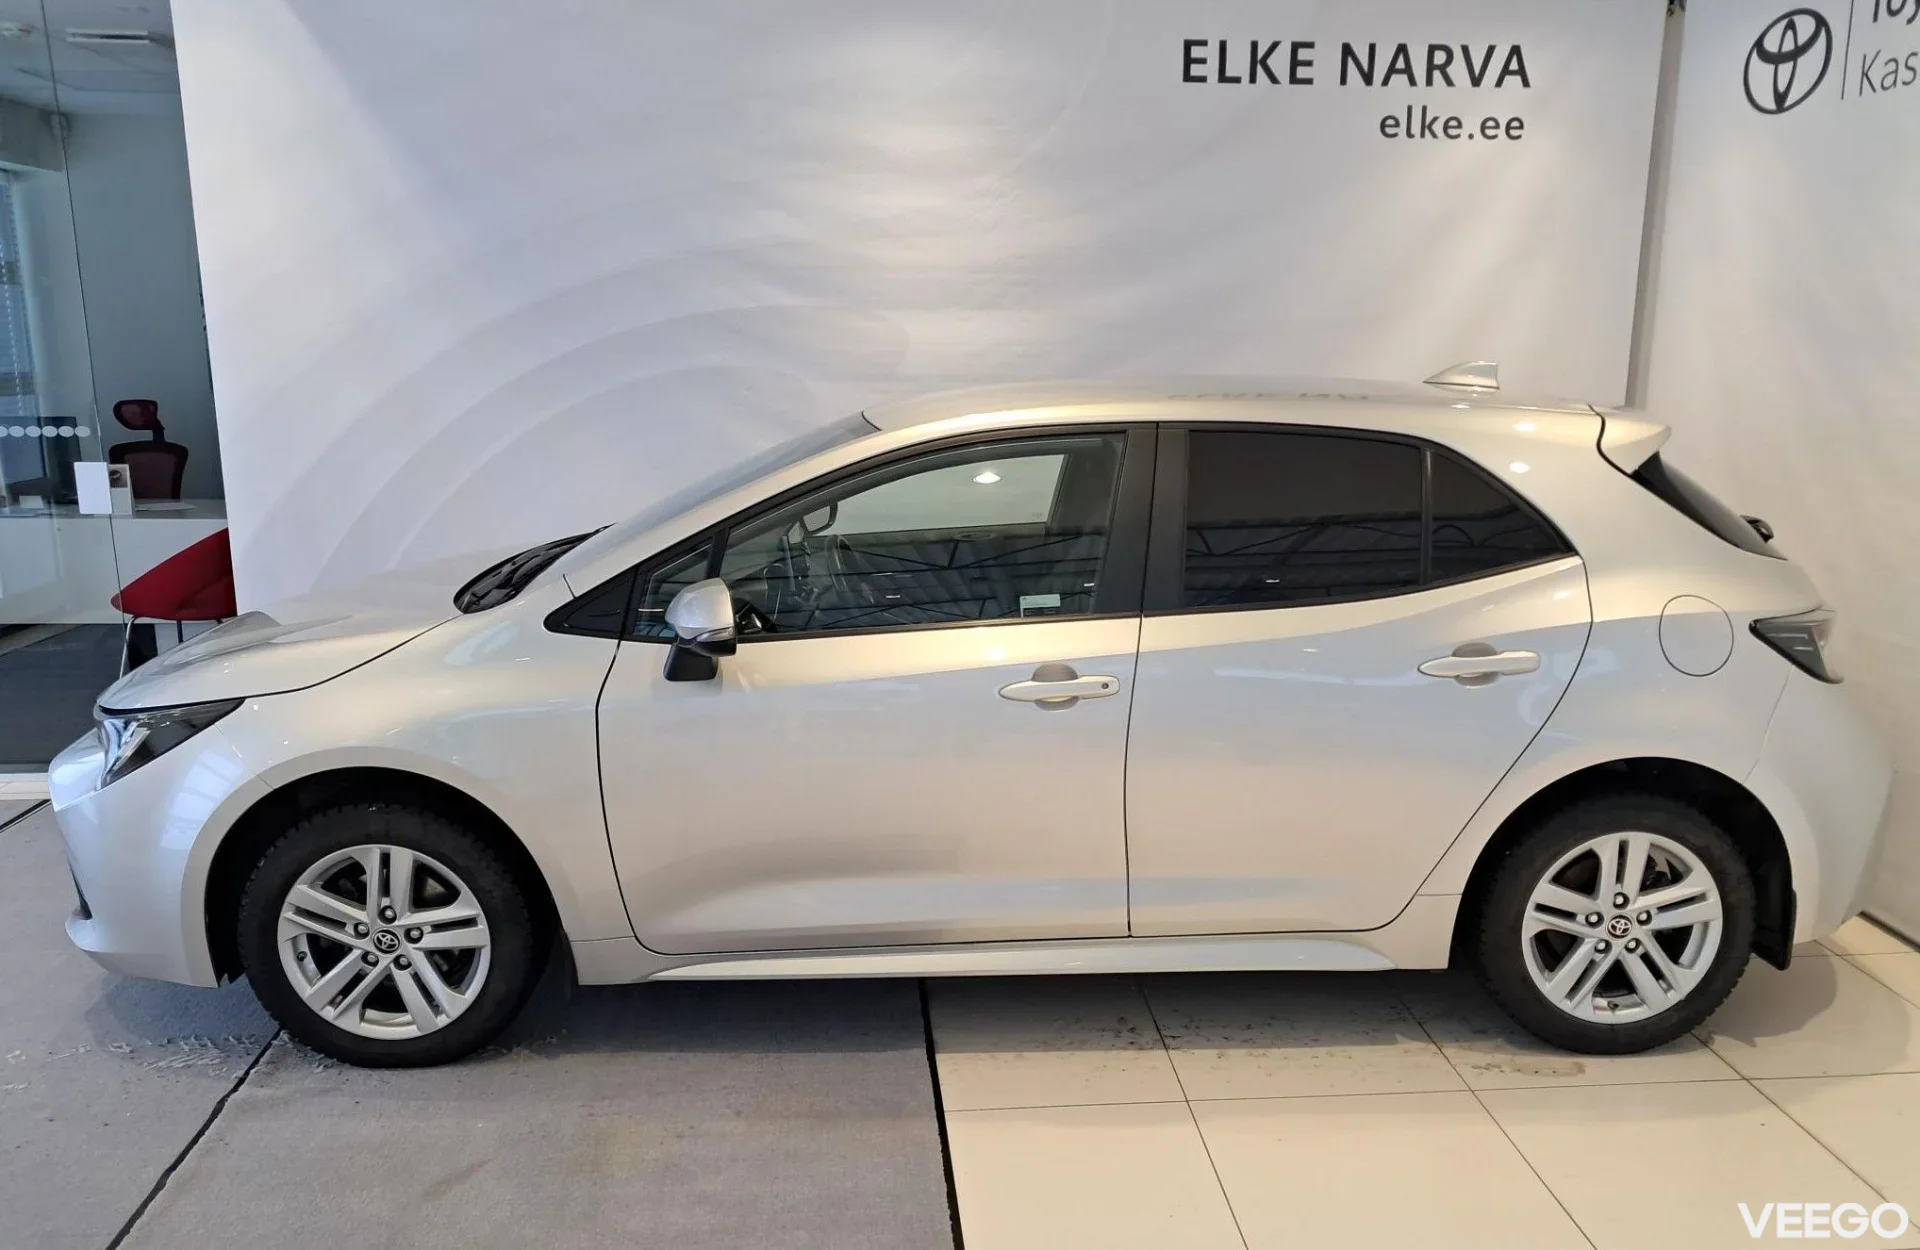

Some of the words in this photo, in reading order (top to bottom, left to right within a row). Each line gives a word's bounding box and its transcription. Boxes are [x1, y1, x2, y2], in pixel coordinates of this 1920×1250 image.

[1183, 39, 1315, 85] ELKE
[1339, 42, 1531, 88] NARVA
[1379, 104, 1525, 141] elke.ee
